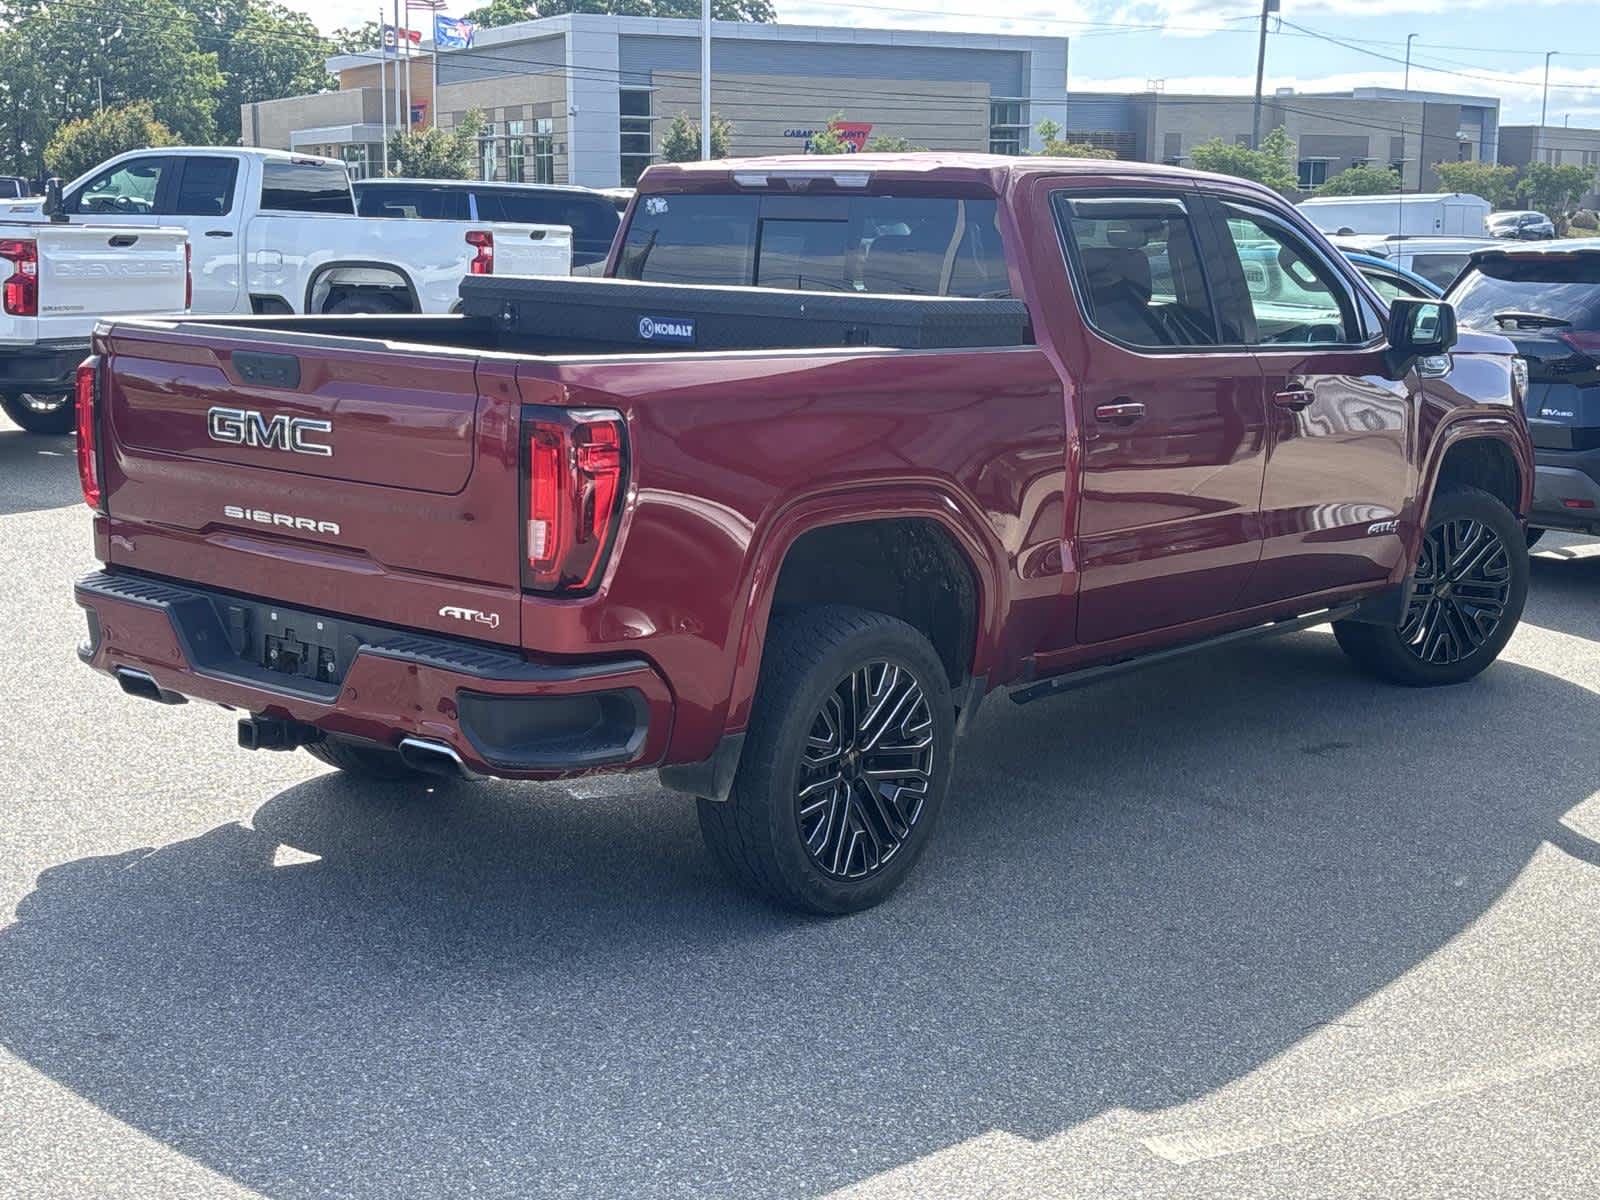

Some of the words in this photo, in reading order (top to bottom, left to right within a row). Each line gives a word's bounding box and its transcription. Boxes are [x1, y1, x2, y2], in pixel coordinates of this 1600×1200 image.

[654, 323, 693, 337] KOBALT
[208, 406, 333, 457] GMC
[224, 505, 340, 535] SIERRA
[439, 606, 499, 629] AT4
